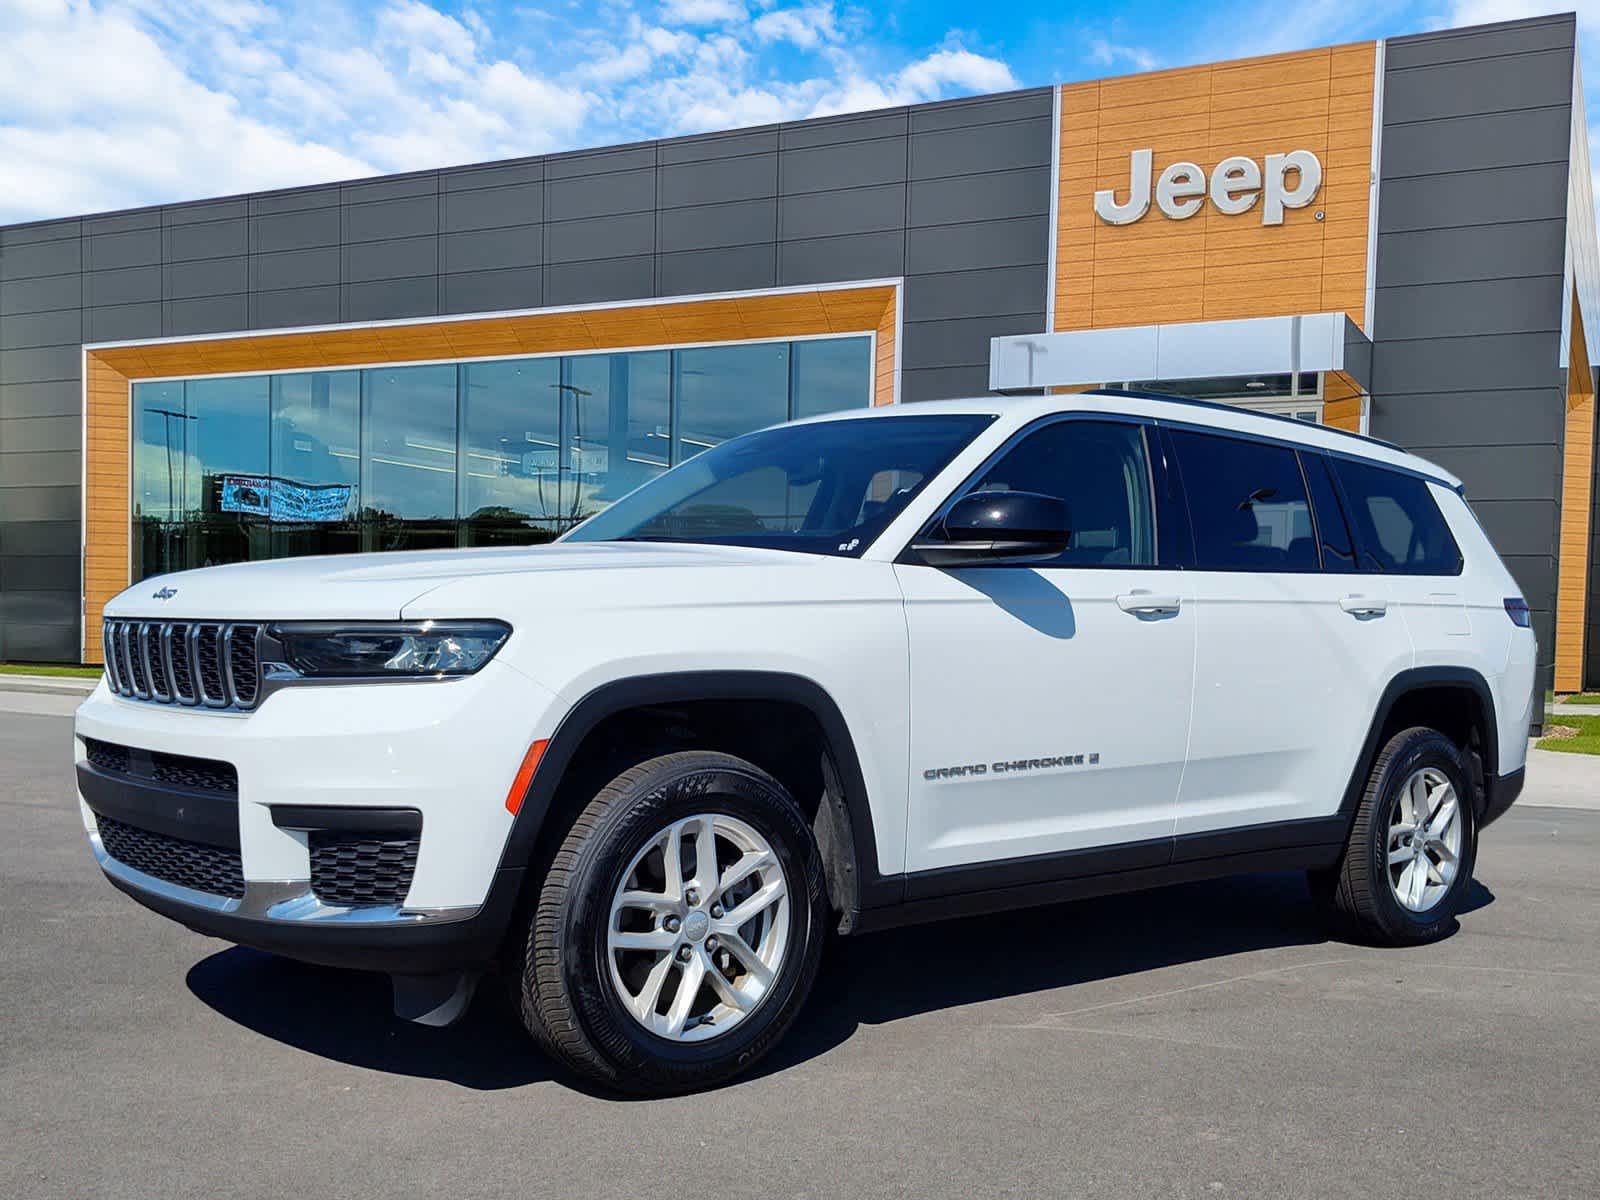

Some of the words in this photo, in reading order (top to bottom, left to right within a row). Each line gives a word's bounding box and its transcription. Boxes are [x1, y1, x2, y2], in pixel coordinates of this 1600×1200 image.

[1094, 148, 1322, 226] Jeep
[923, 763, 987, 781] GRAND
[992, 754, 1084, 773] CHEROKEE
